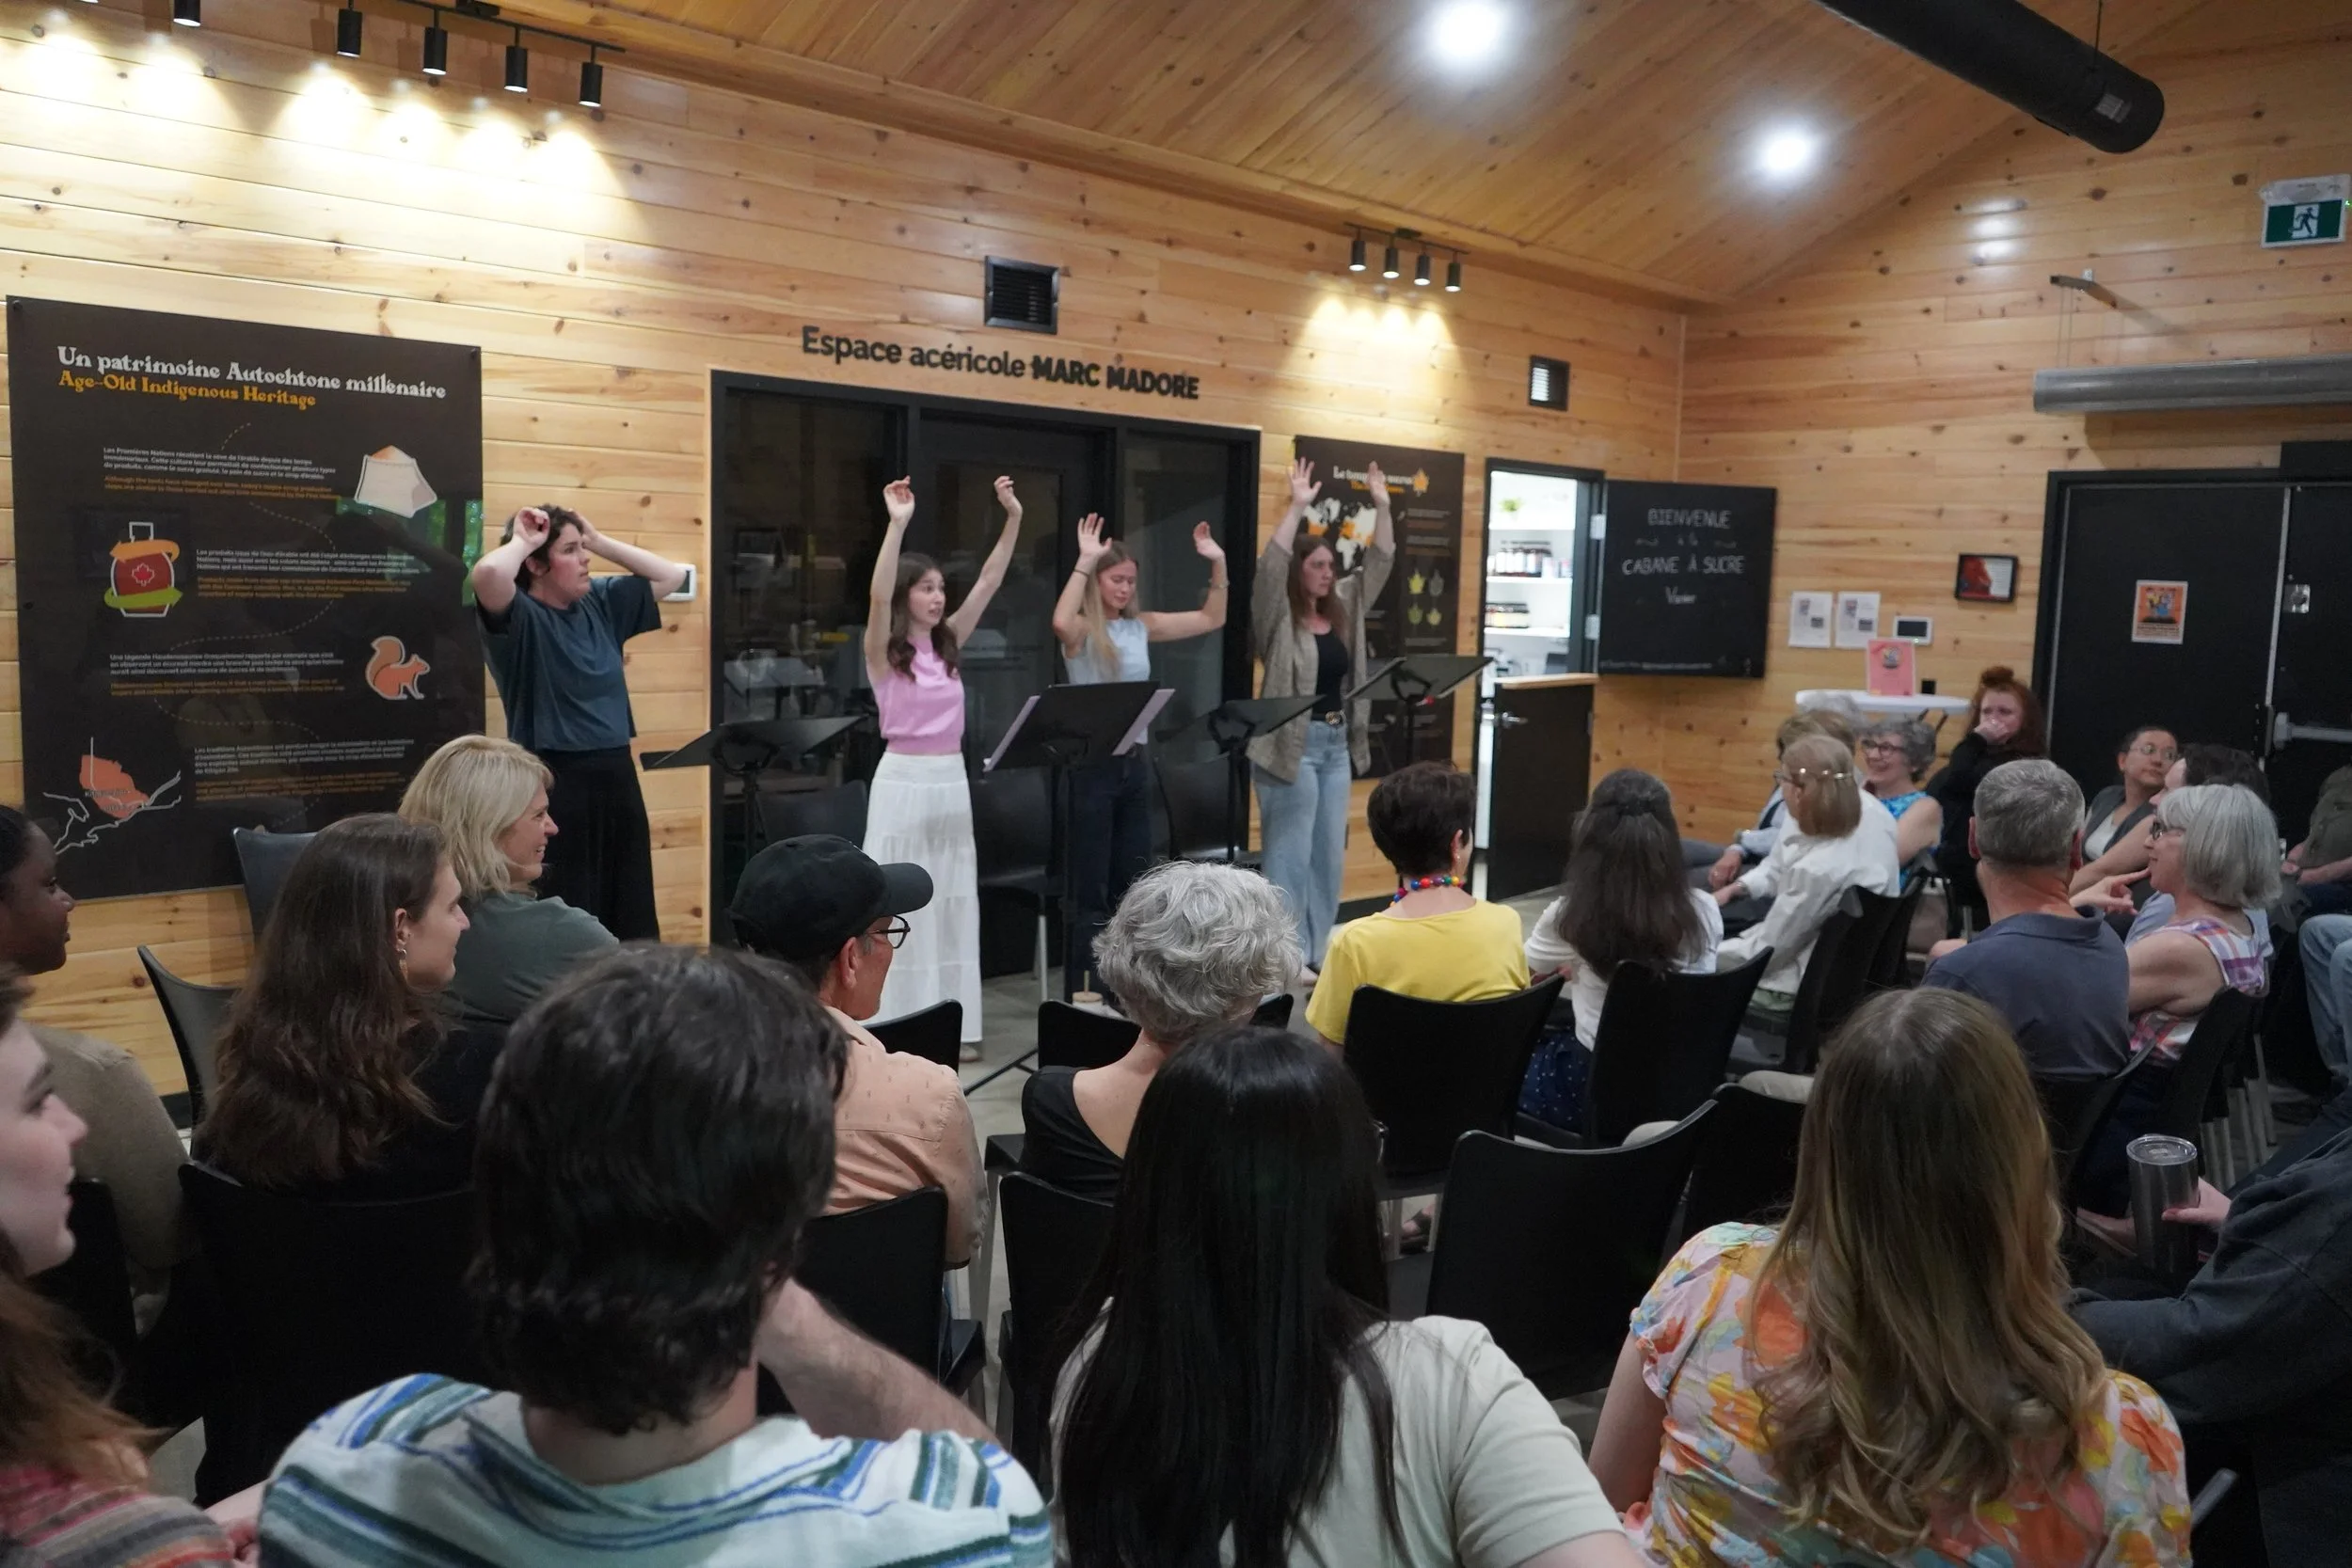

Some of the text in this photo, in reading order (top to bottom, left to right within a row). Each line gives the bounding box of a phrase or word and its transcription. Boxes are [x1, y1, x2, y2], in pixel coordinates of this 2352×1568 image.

[57, 346, 446, 398] Un patrimoine Autochtone millénaire
[802, 325, 1200, 400] Espace acéricole MARC MADORE
[58, 370, 316, 410] Age-Old Indigenous Heritage
[1647, 508, 1731, 529] BIENVENUE
[1622, 556, 1680, 575] CABANE
[1703, 555, 1745, 575] SUCRE
